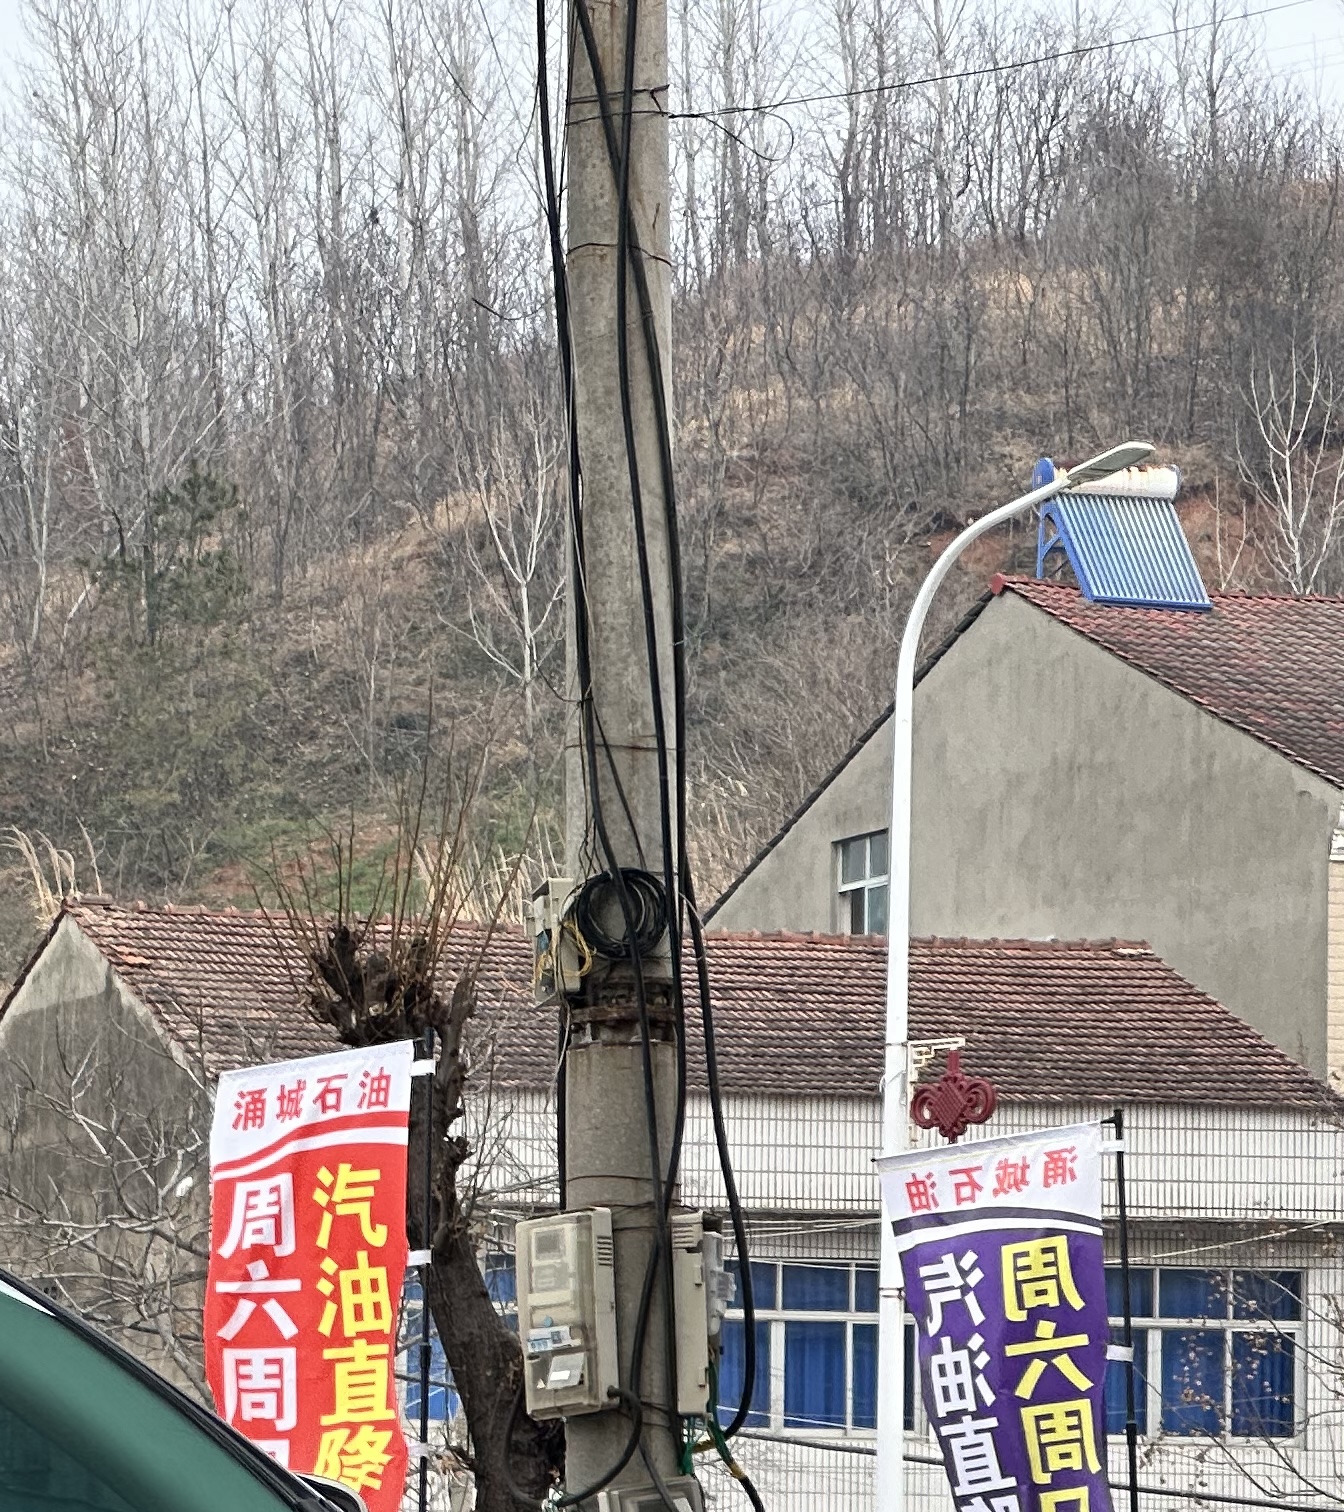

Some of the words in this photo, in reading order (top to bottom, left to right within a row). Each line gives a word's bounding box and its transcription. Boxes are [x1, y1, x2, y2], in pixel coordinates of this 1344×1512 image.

[232, 1066, 392, 1131] 涌城石油
[312, 1163, 396, 1493] 汽油直降
